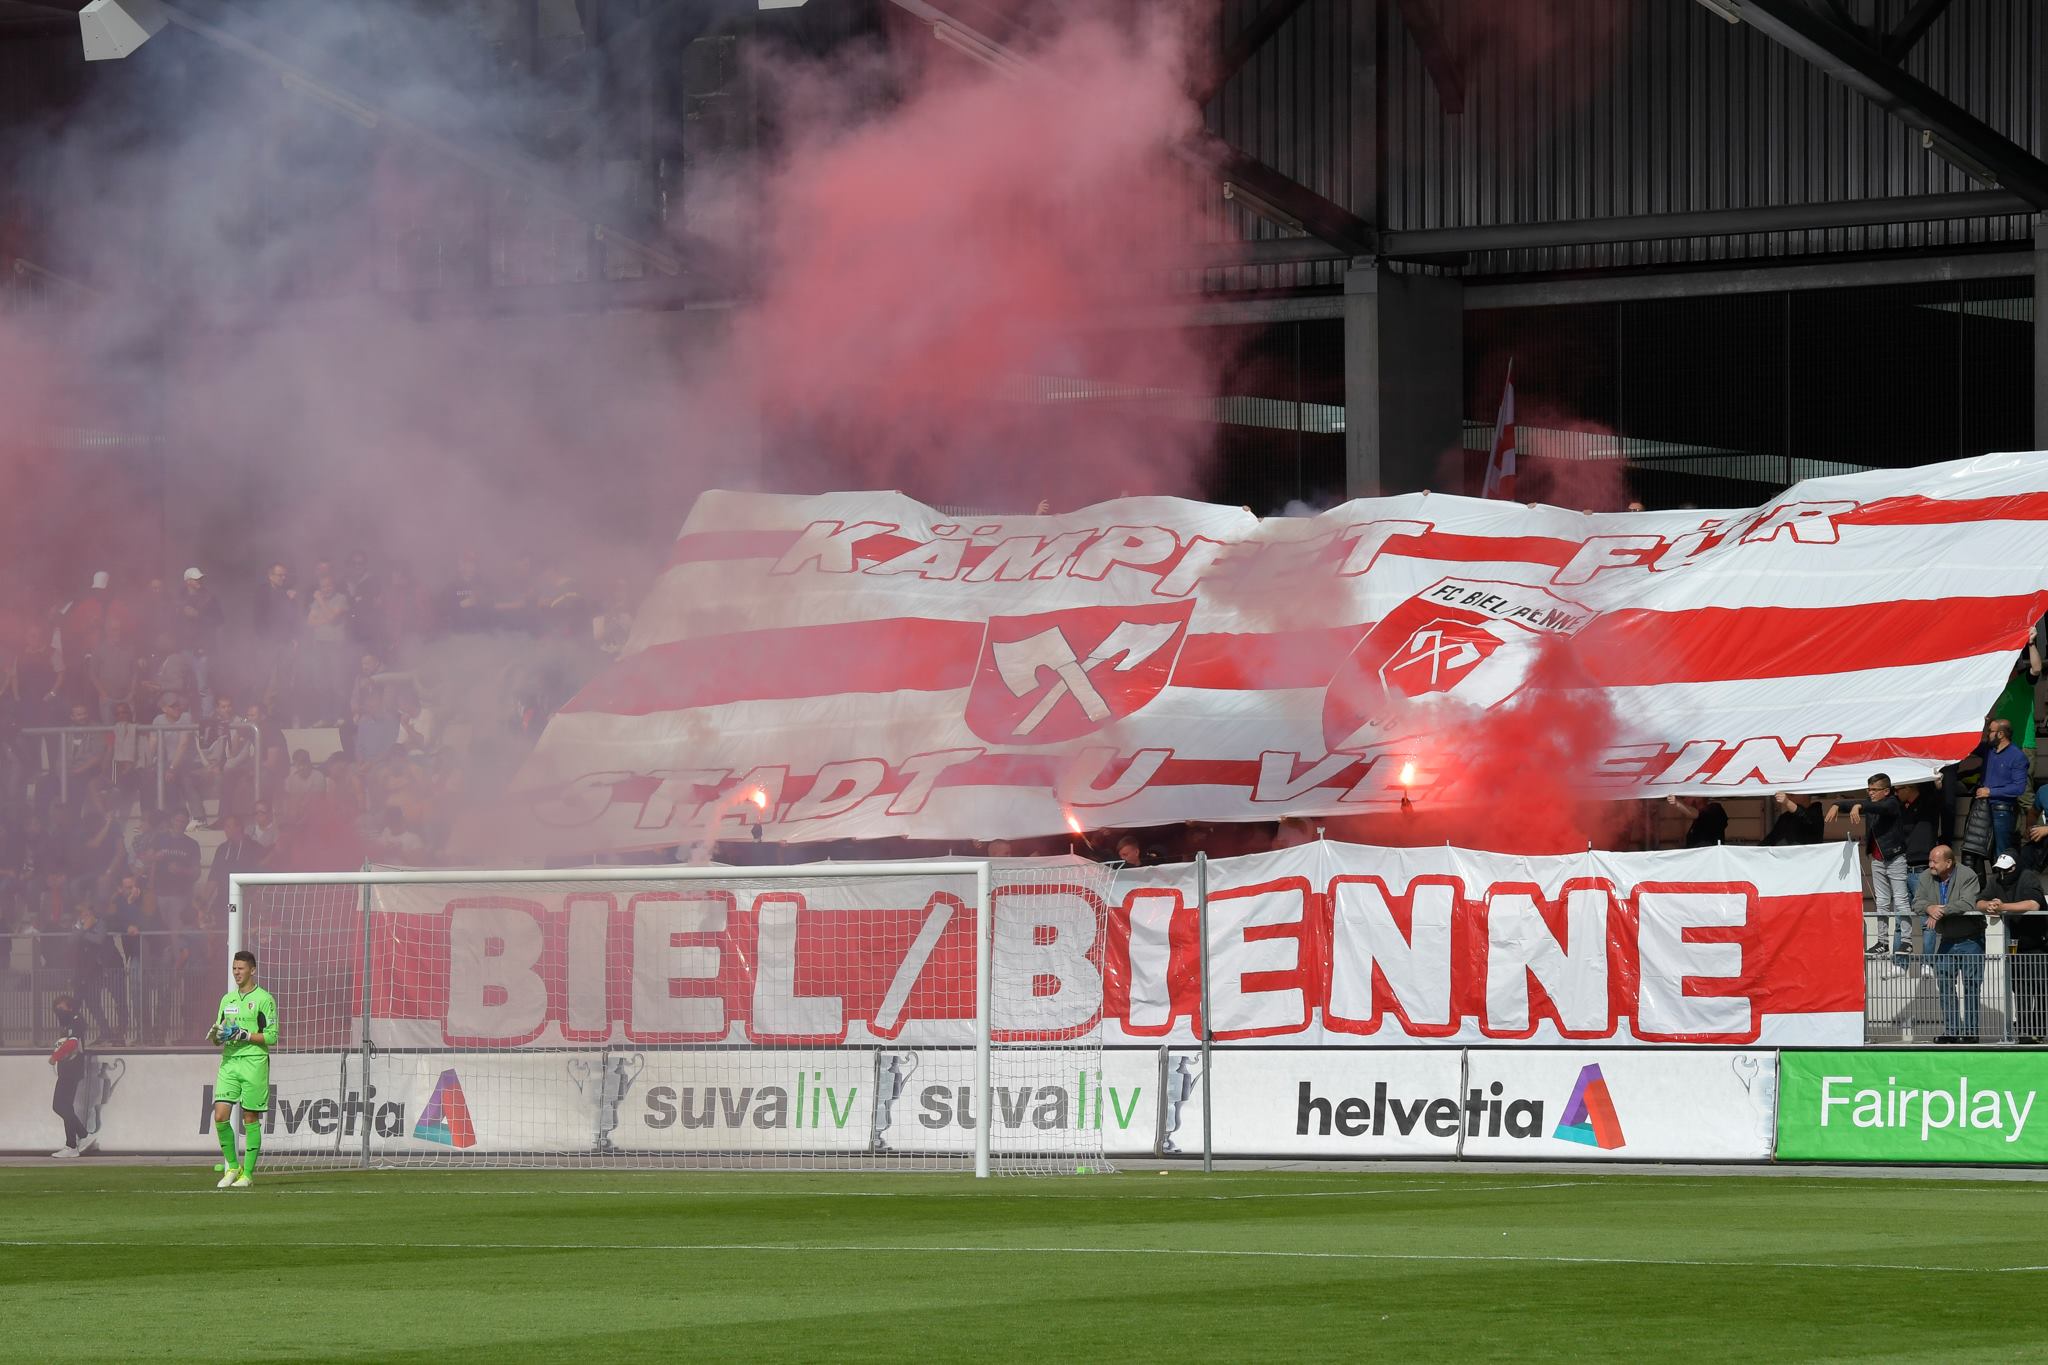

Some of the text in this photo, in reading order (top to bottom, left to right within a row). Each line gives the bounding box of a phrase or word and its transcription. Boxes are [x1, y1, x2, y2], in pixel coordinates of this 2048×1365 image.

[1549, 500, 1862, 585] FÜR
[1431, 584, 1465, 601] FC
[530, 733, 1842, 829] STADT U VEEIN
[199, 1084, 406, 1138] hlvetia
[643, 1071, 857, 1130] suvaliv
[918, 1071, 1141, 1130] suvaliv
[1296, 1081, 1545, 1139] helvetia
[1820, 1076, 2036, 1141] Fairplay
